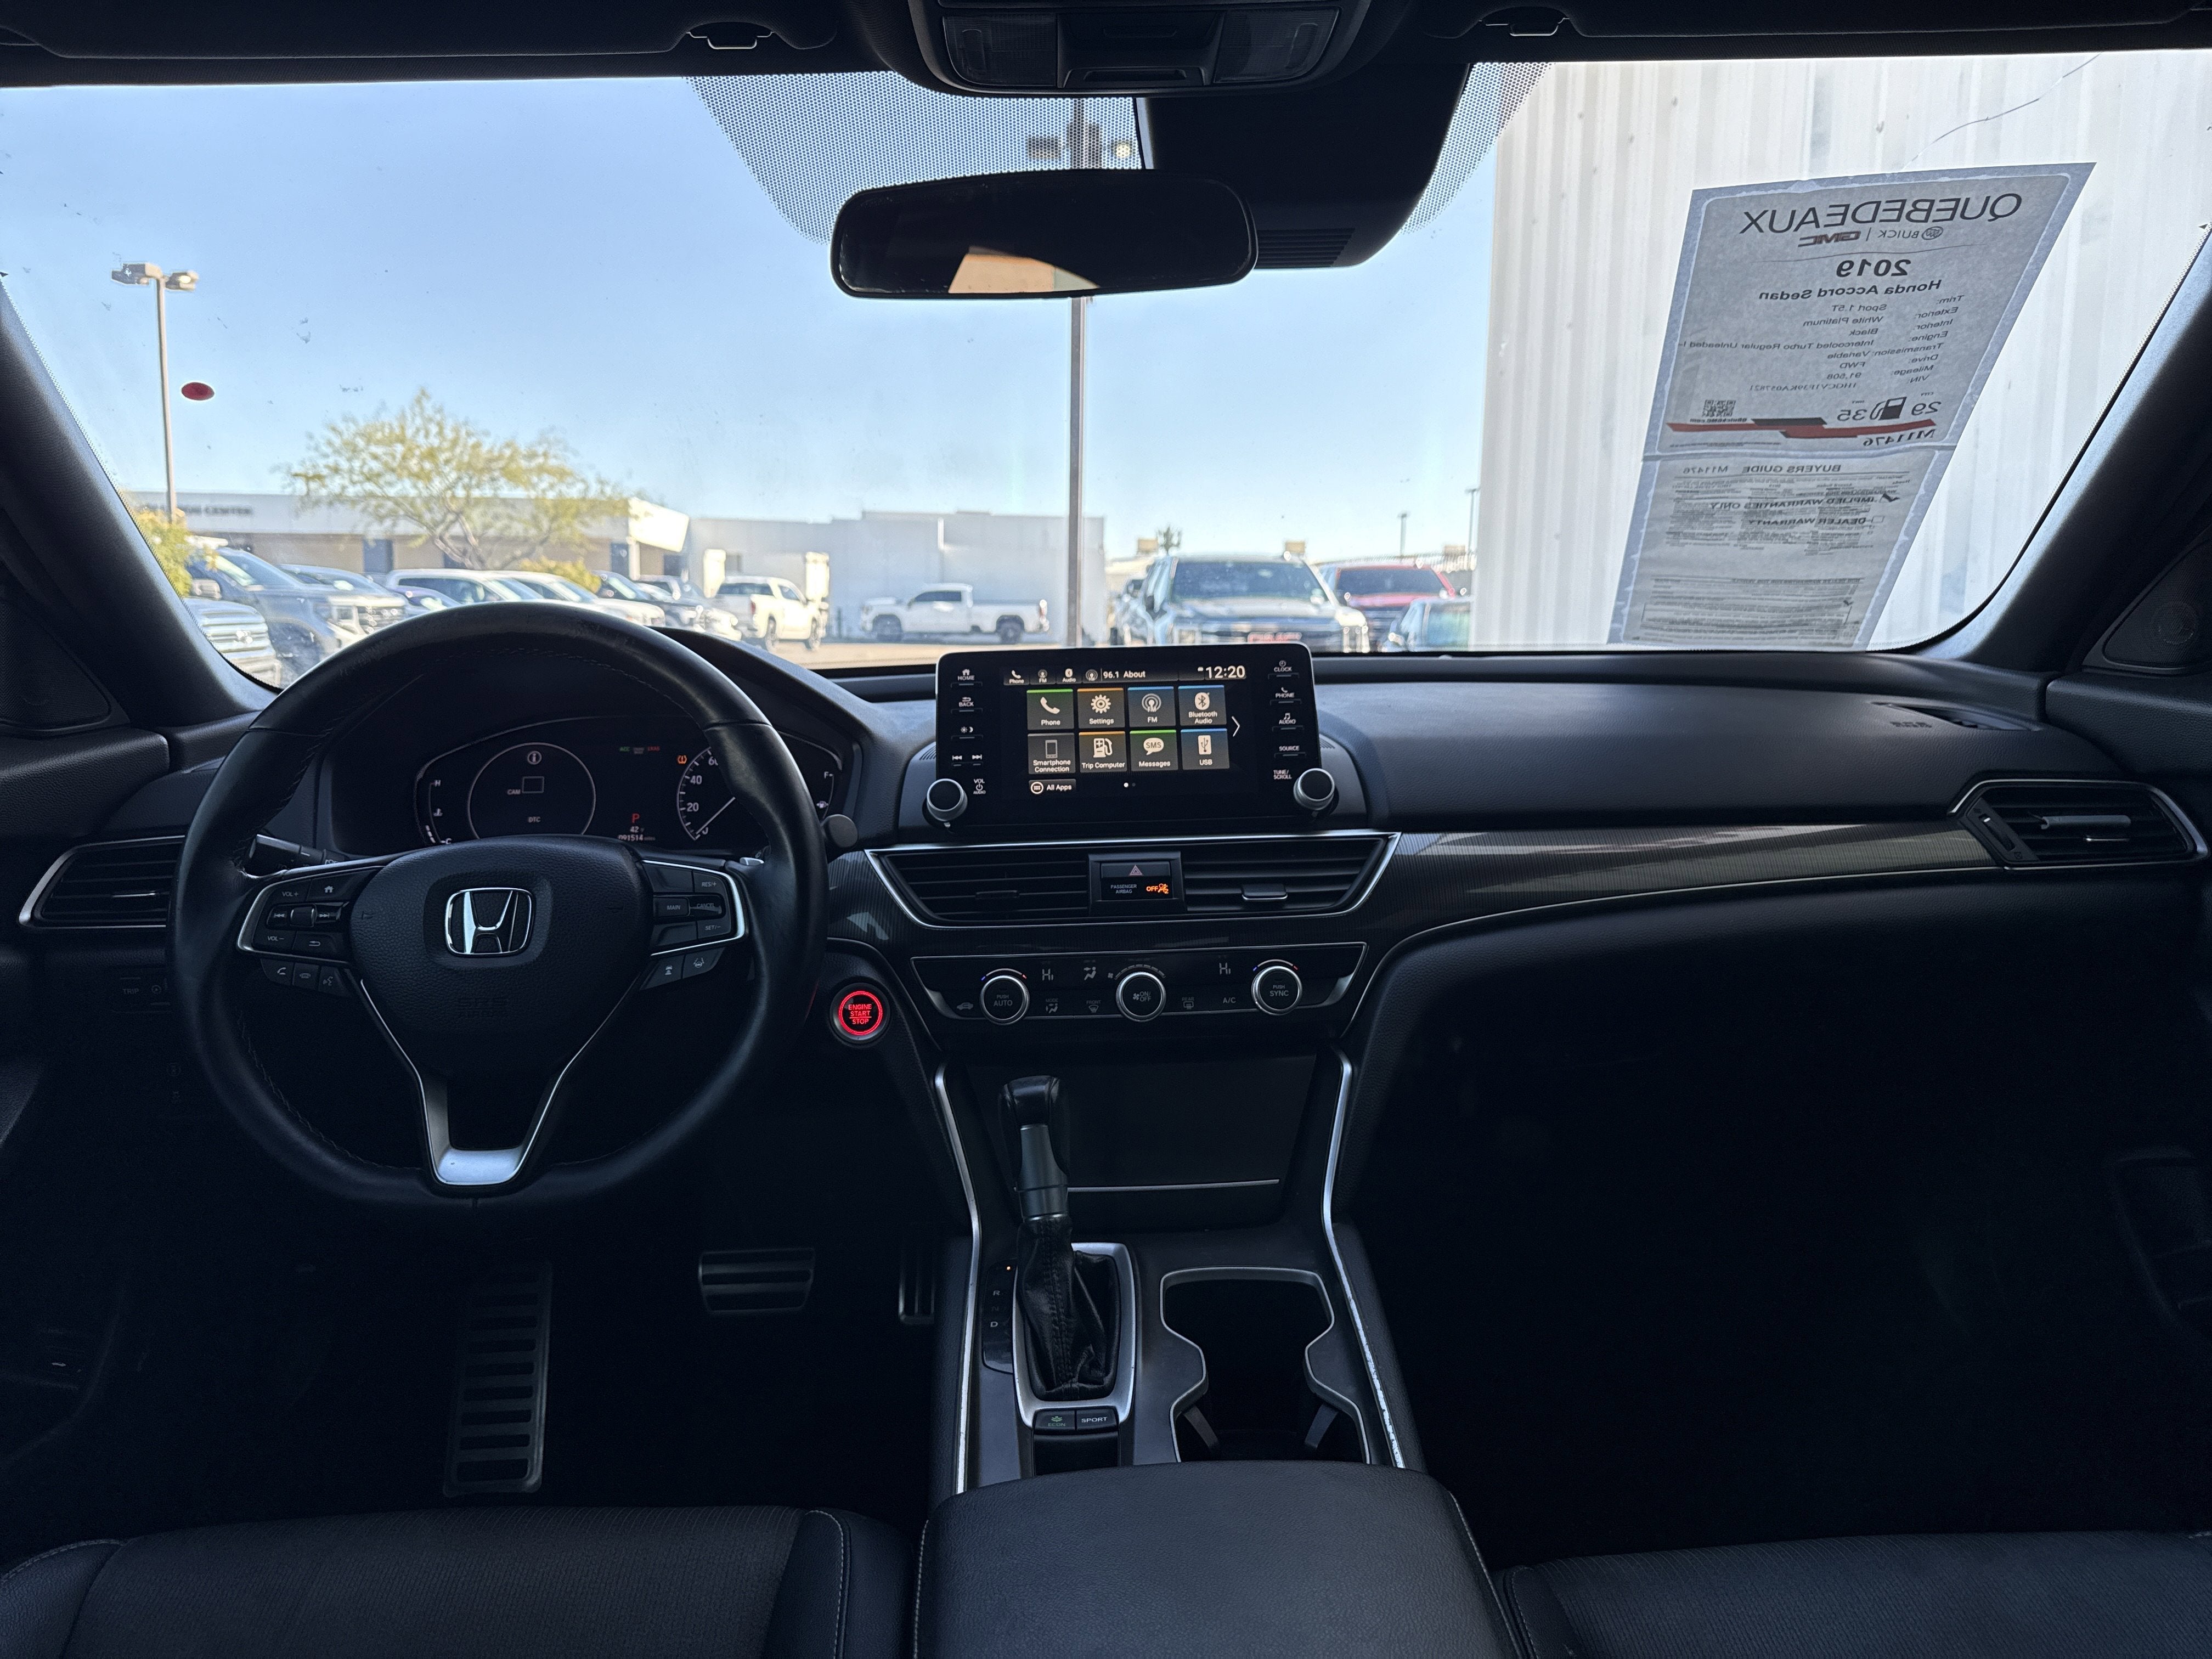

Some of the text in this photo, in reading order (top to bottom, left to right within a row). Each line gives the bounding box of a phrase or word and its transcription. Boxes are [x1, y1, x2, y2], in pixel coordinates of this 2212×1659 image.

[1206, 665, 1245, 679] 12:20
[690, 775, 703, 785] 40
[686, 802, 699, 812] 20
[632, 813, 640, 823] P
